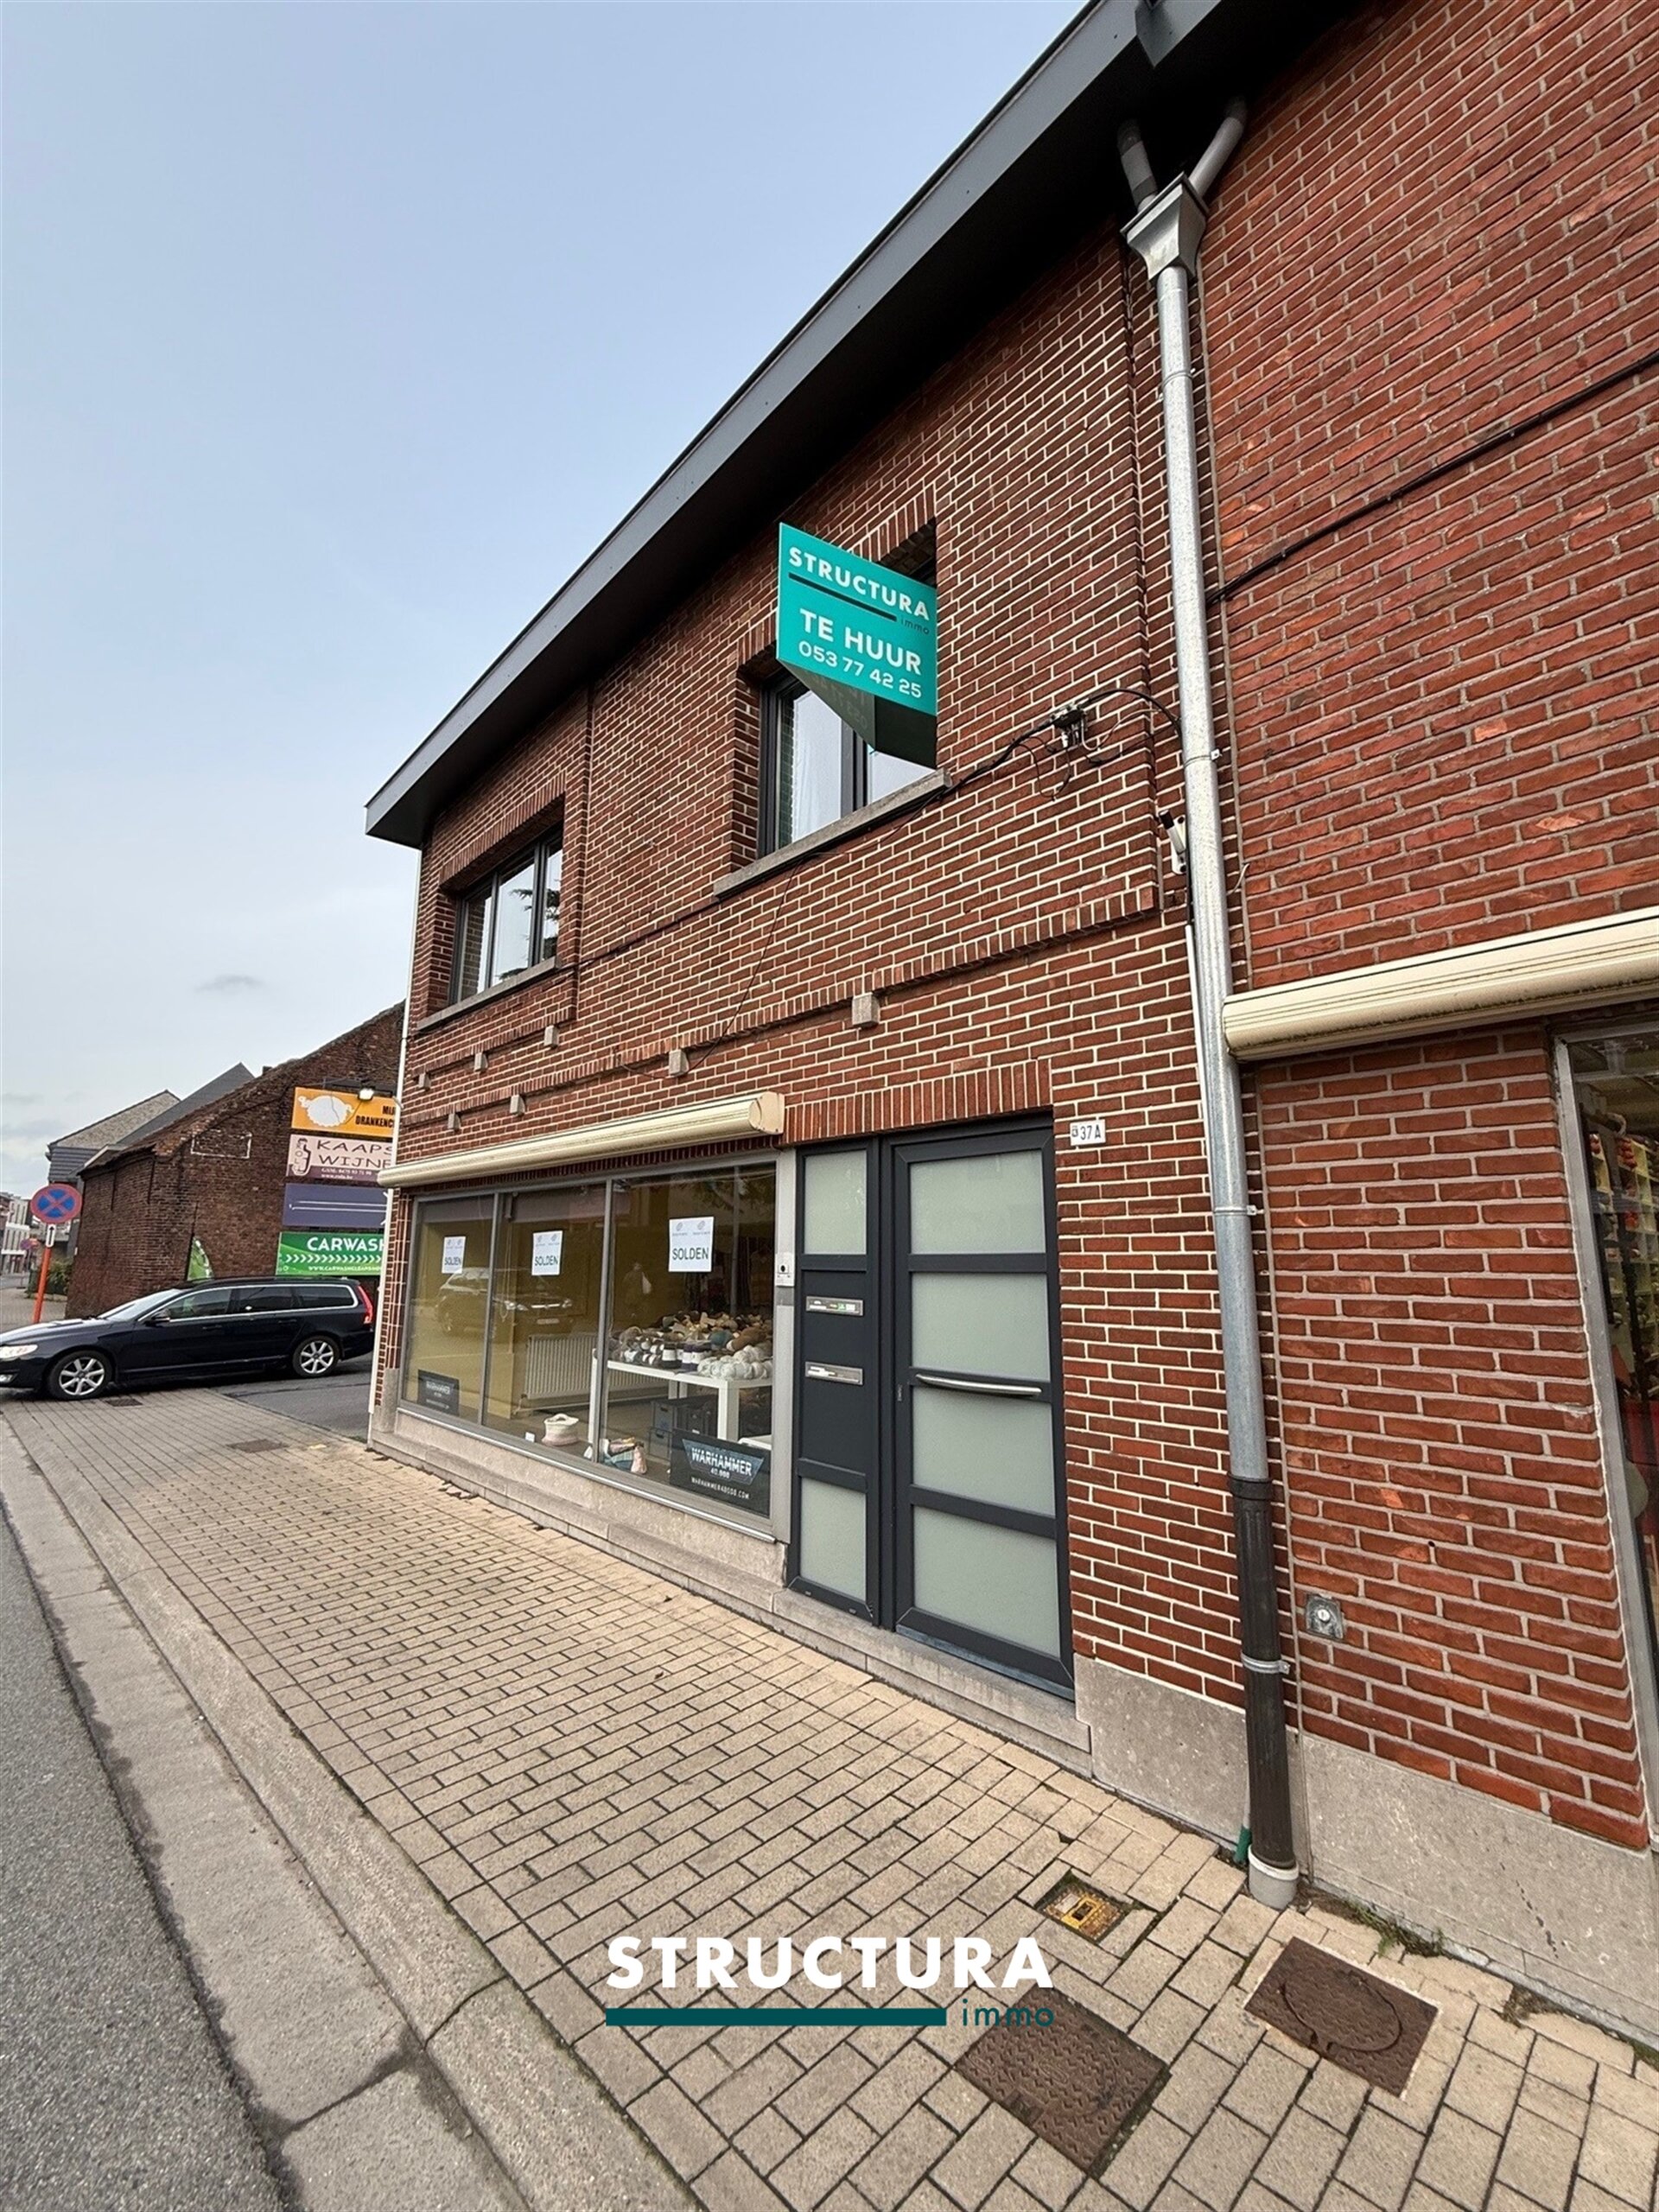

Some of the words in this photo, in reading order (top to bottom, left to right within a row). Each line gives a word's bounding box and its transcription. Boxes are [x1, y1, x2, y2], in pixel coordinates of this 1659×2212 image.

[789, 547, 929, 620] STRUCTURA
[901, 615, 930, 635] immo
[799, 608, 834, 642] TE
[845, 626, 921, 675] HUUR
[798, 641, 837, 667] 053
[842, 657, 864, 677] 77
[869, 669, 893, 689] 42
[899, 679, 921, 698] 25
[444, 1256, 461, 1266] SOLDEN
[535, 1255, 558, 1267] SOLDEN
[672, 1247, 709, 1260] SOLDEN
[691, 1447, 752, 1476] WARHAMMER
